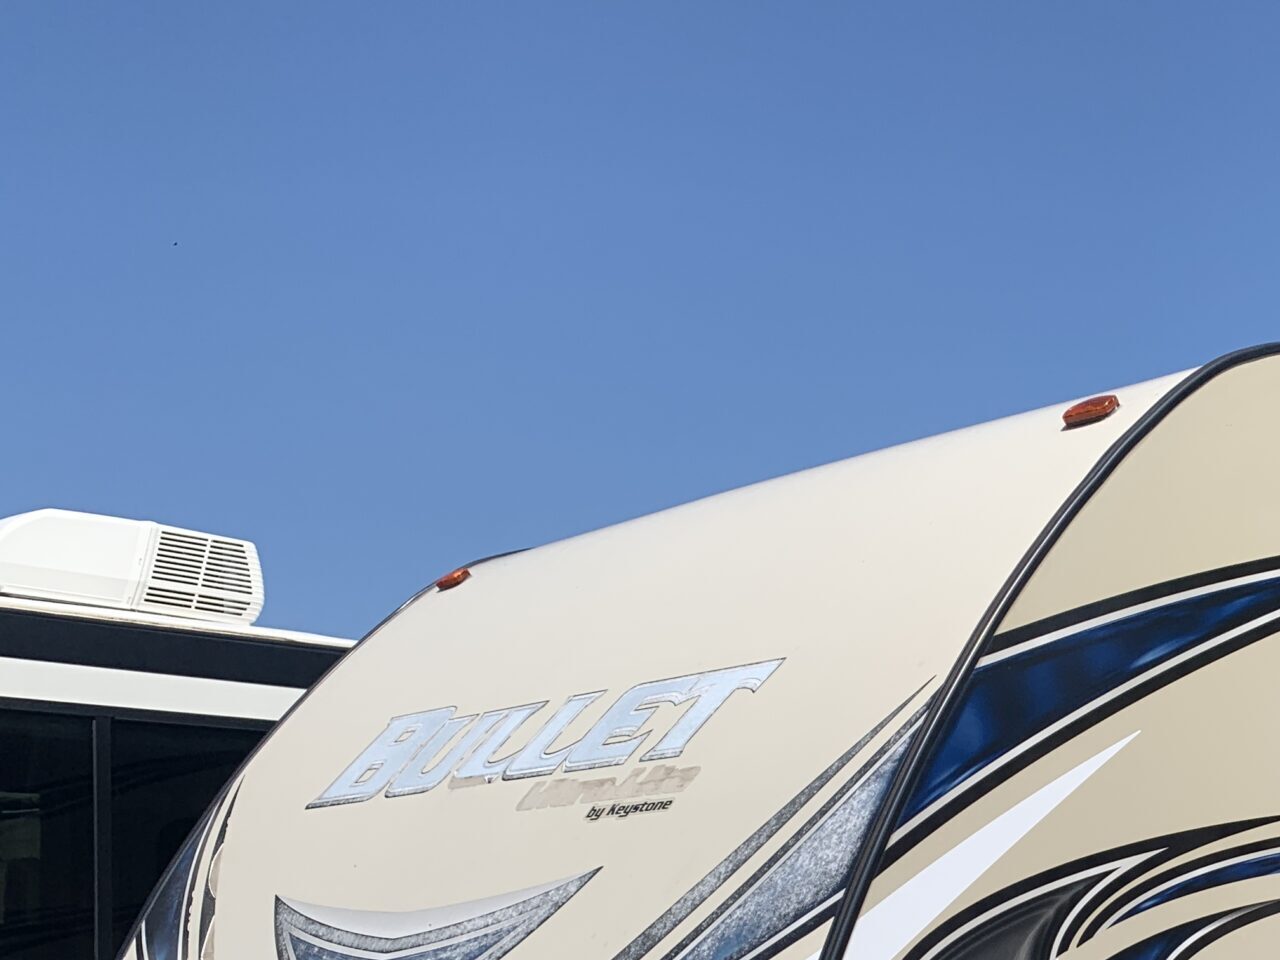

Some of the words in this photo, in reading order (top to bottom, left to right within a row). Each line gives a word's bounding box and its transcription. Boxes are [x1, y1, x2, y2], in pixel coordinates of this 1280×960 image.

[305, 657, 787, 810] BULLET
[586, 806, 606, 821] by
[606, 800, 673, 818] Keystone
